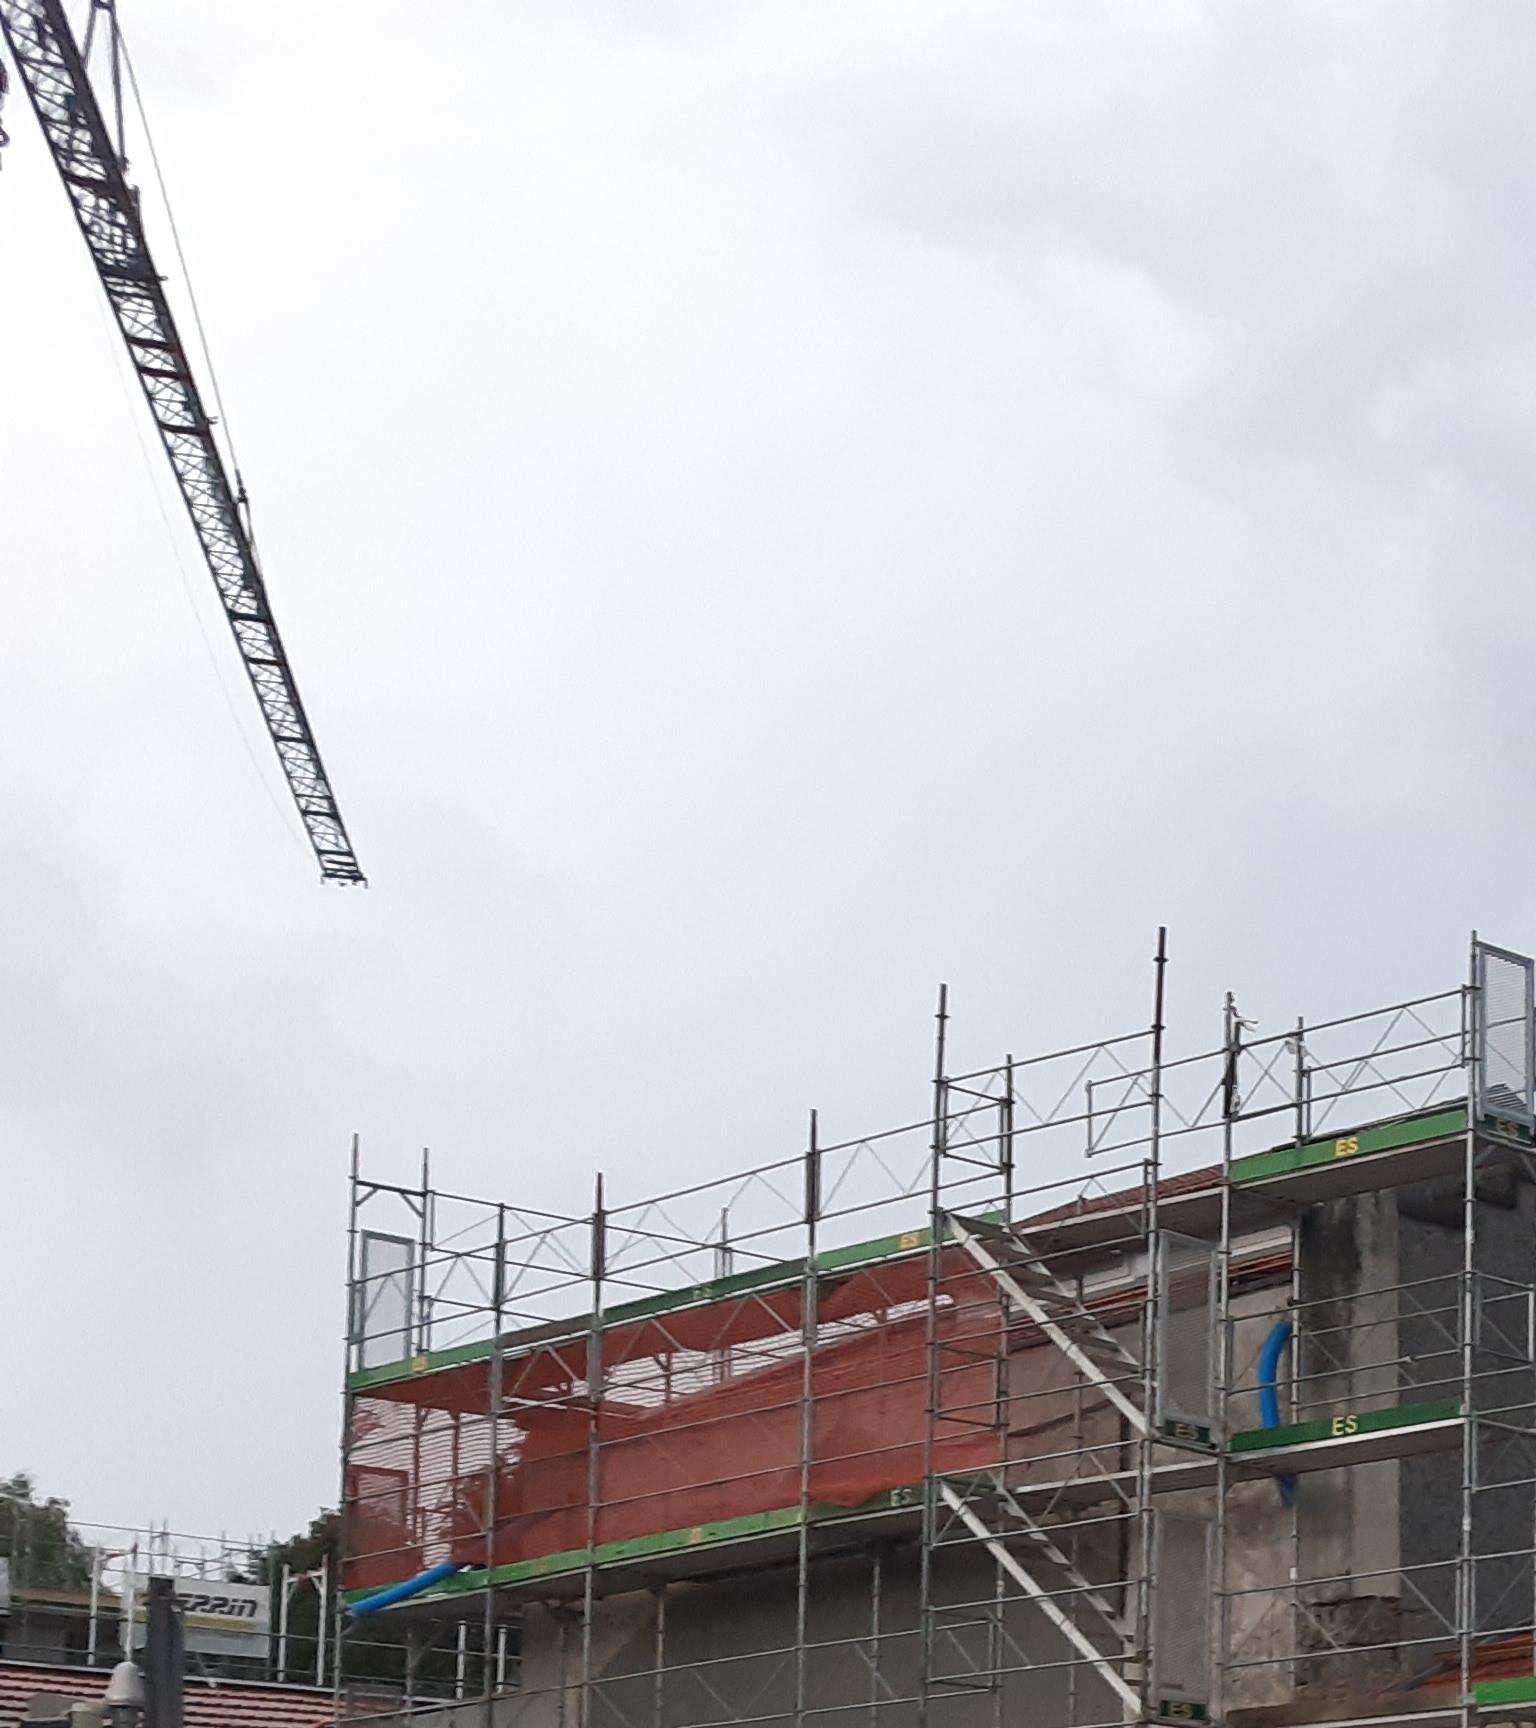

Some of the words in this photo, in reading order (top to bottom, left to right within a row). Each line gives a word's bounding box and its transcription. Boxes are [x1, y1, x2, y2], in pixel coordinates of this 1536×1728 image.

[1335, 1138, 1359, 1157] ES
[1331, 1414, 1358, 1435] ES
[1167, 1702, 1194, 1720] ES
